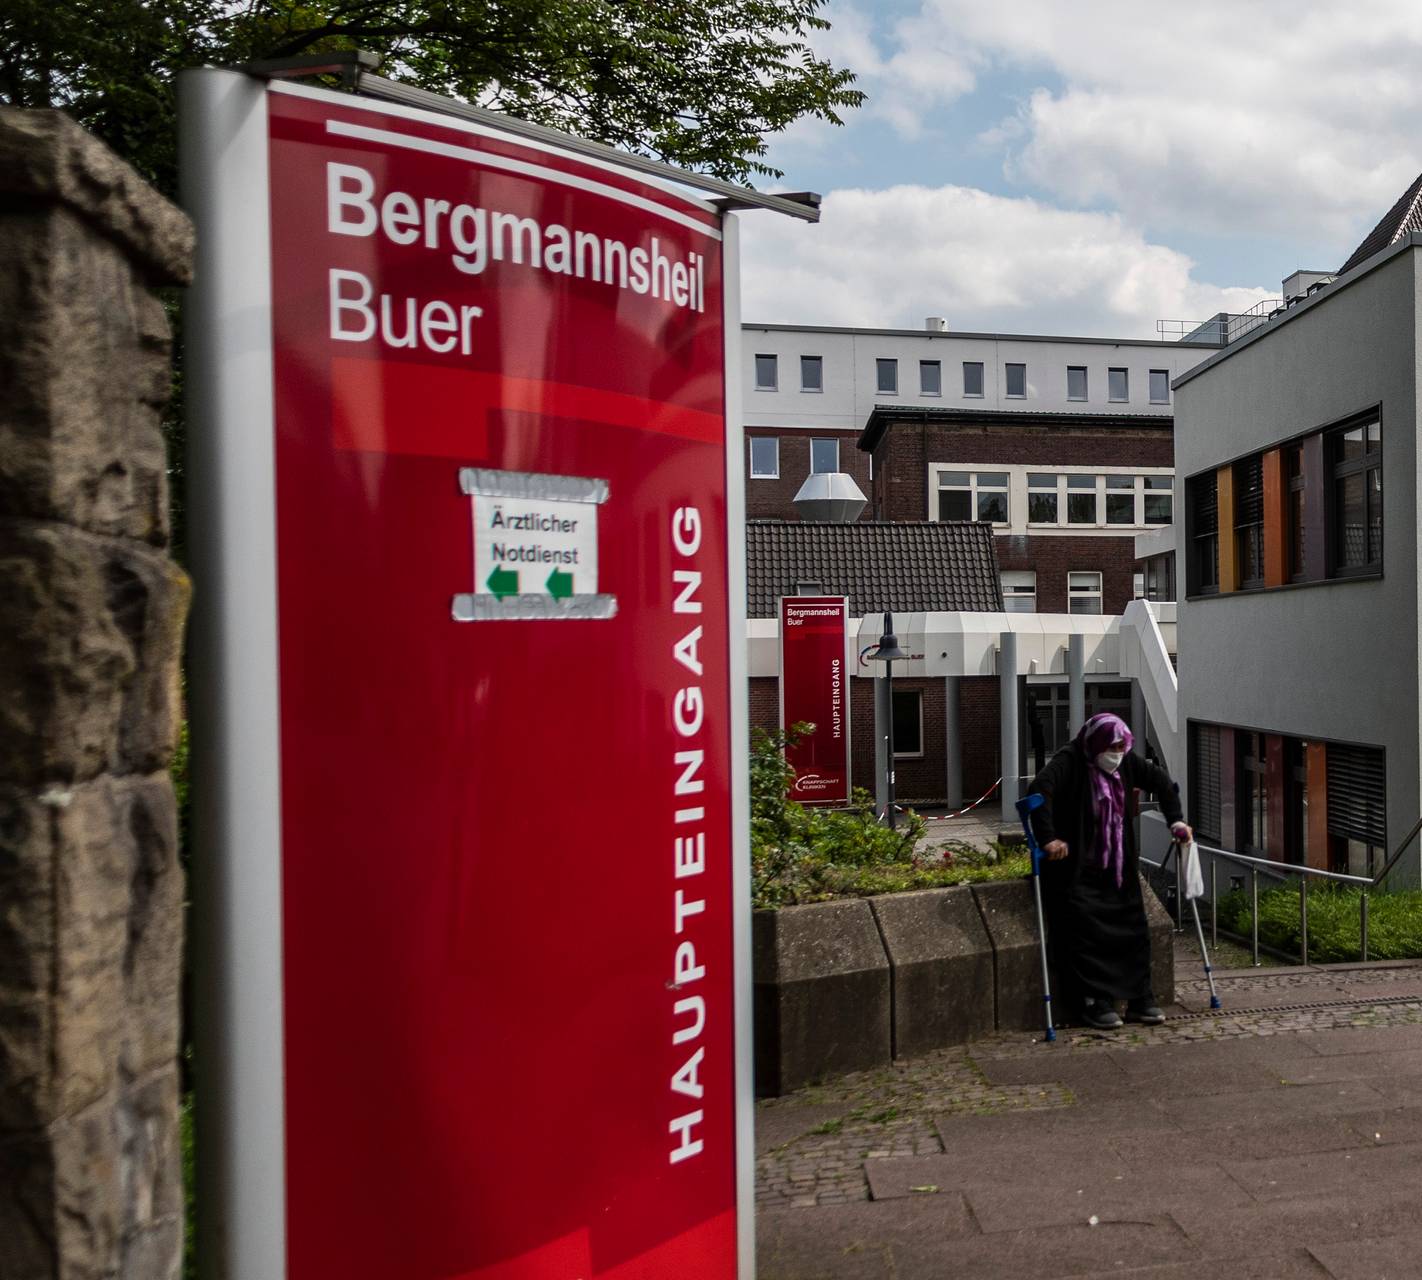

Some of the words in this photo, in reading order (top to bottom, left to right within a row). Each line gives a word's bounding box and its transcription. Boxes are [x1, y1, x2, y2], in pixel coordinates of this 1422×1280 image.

[326, 161, 705, 313] Bergmannsheil
[328, 268, 483, 355] Buer
[491, 505, 578, 533] Ärztlicher
[492, 543, 579, 564] Notdienst
[787, 608, 840, 618] Bergmannsheil
[787, 618, 804, 626] Buer
[832, 659, 841, 738] HAUPTEINGANG
[670, 505, 706, 1165] HAUPTEINGANG
